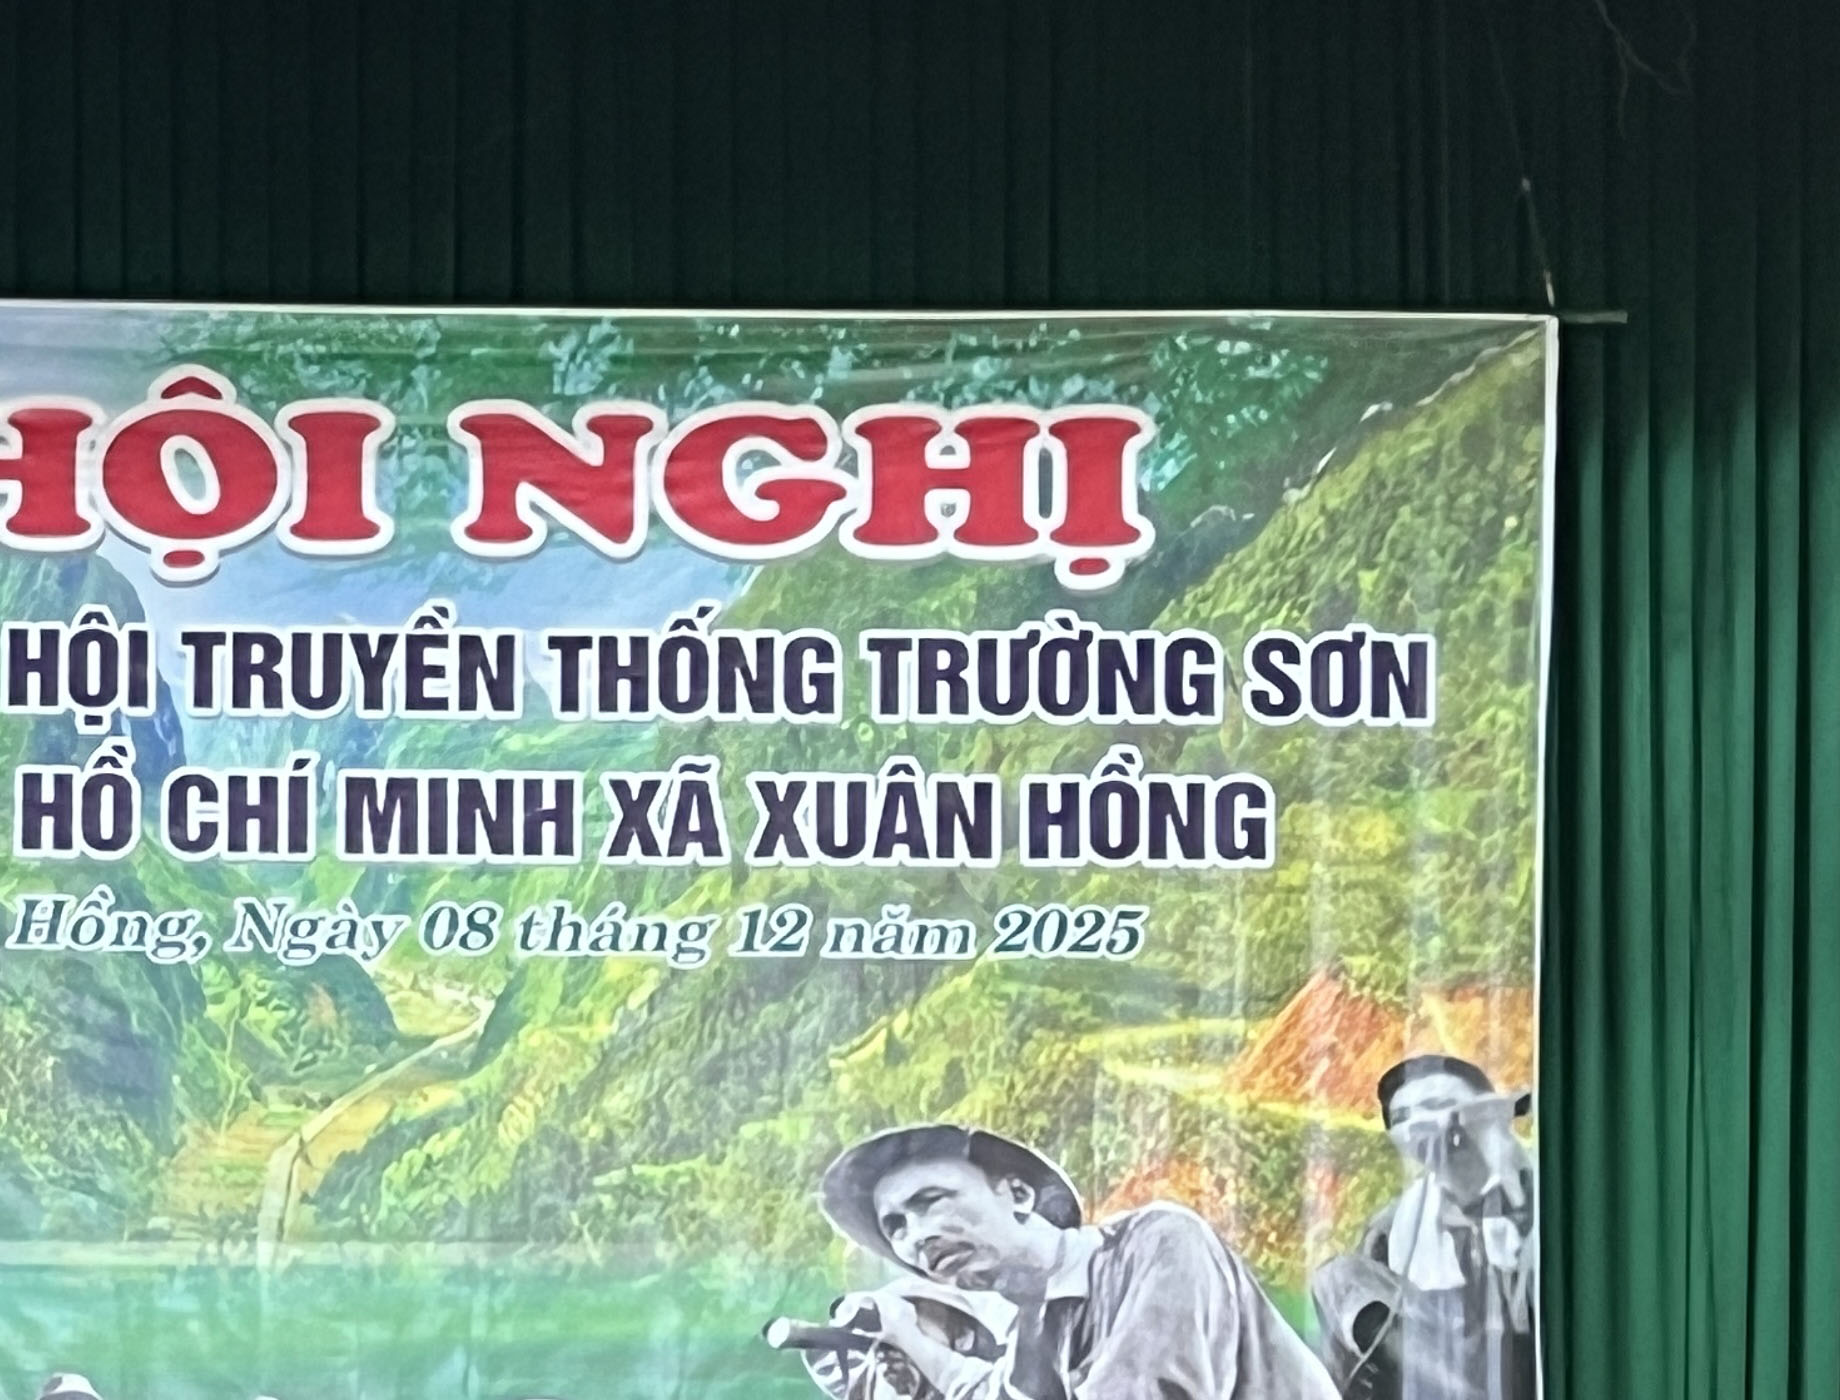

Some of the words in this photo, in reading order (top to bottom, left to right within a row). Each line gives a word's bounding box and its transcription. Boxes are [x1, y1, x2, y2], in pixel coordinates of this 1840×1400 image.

[458, 411, 1143, 577] NGHỊ
[8, 610, 149, 726] HỘI
[180, 605, 516, 712] TRUYỀN
[547, 605, 835, 715] THỐNG
[867, 616, 1216, 717] TRƯỜNG
[1249, 631, 1429, 719] SƠN
[22, 744, 134, 853] HỒ
[167, 757, 312, 853] CHÍ
[344, 776, 575, 857] MINH
[607, 762, 724, 858] XÃ
[753, 763, 993, 860] XUÂN
[1027, 752, 1267, 860] HỒNG
[10, 888, 208, 961] Hồng,
[228, 900, 404, 961] Ngày
[423, 904, 496, 952] 08
[519, 903, 714, 964] tháng
[738, 907, 807, 954] 12
[829, 910, 972, 956] năm
[993, 908, 1146, 957] 2025
